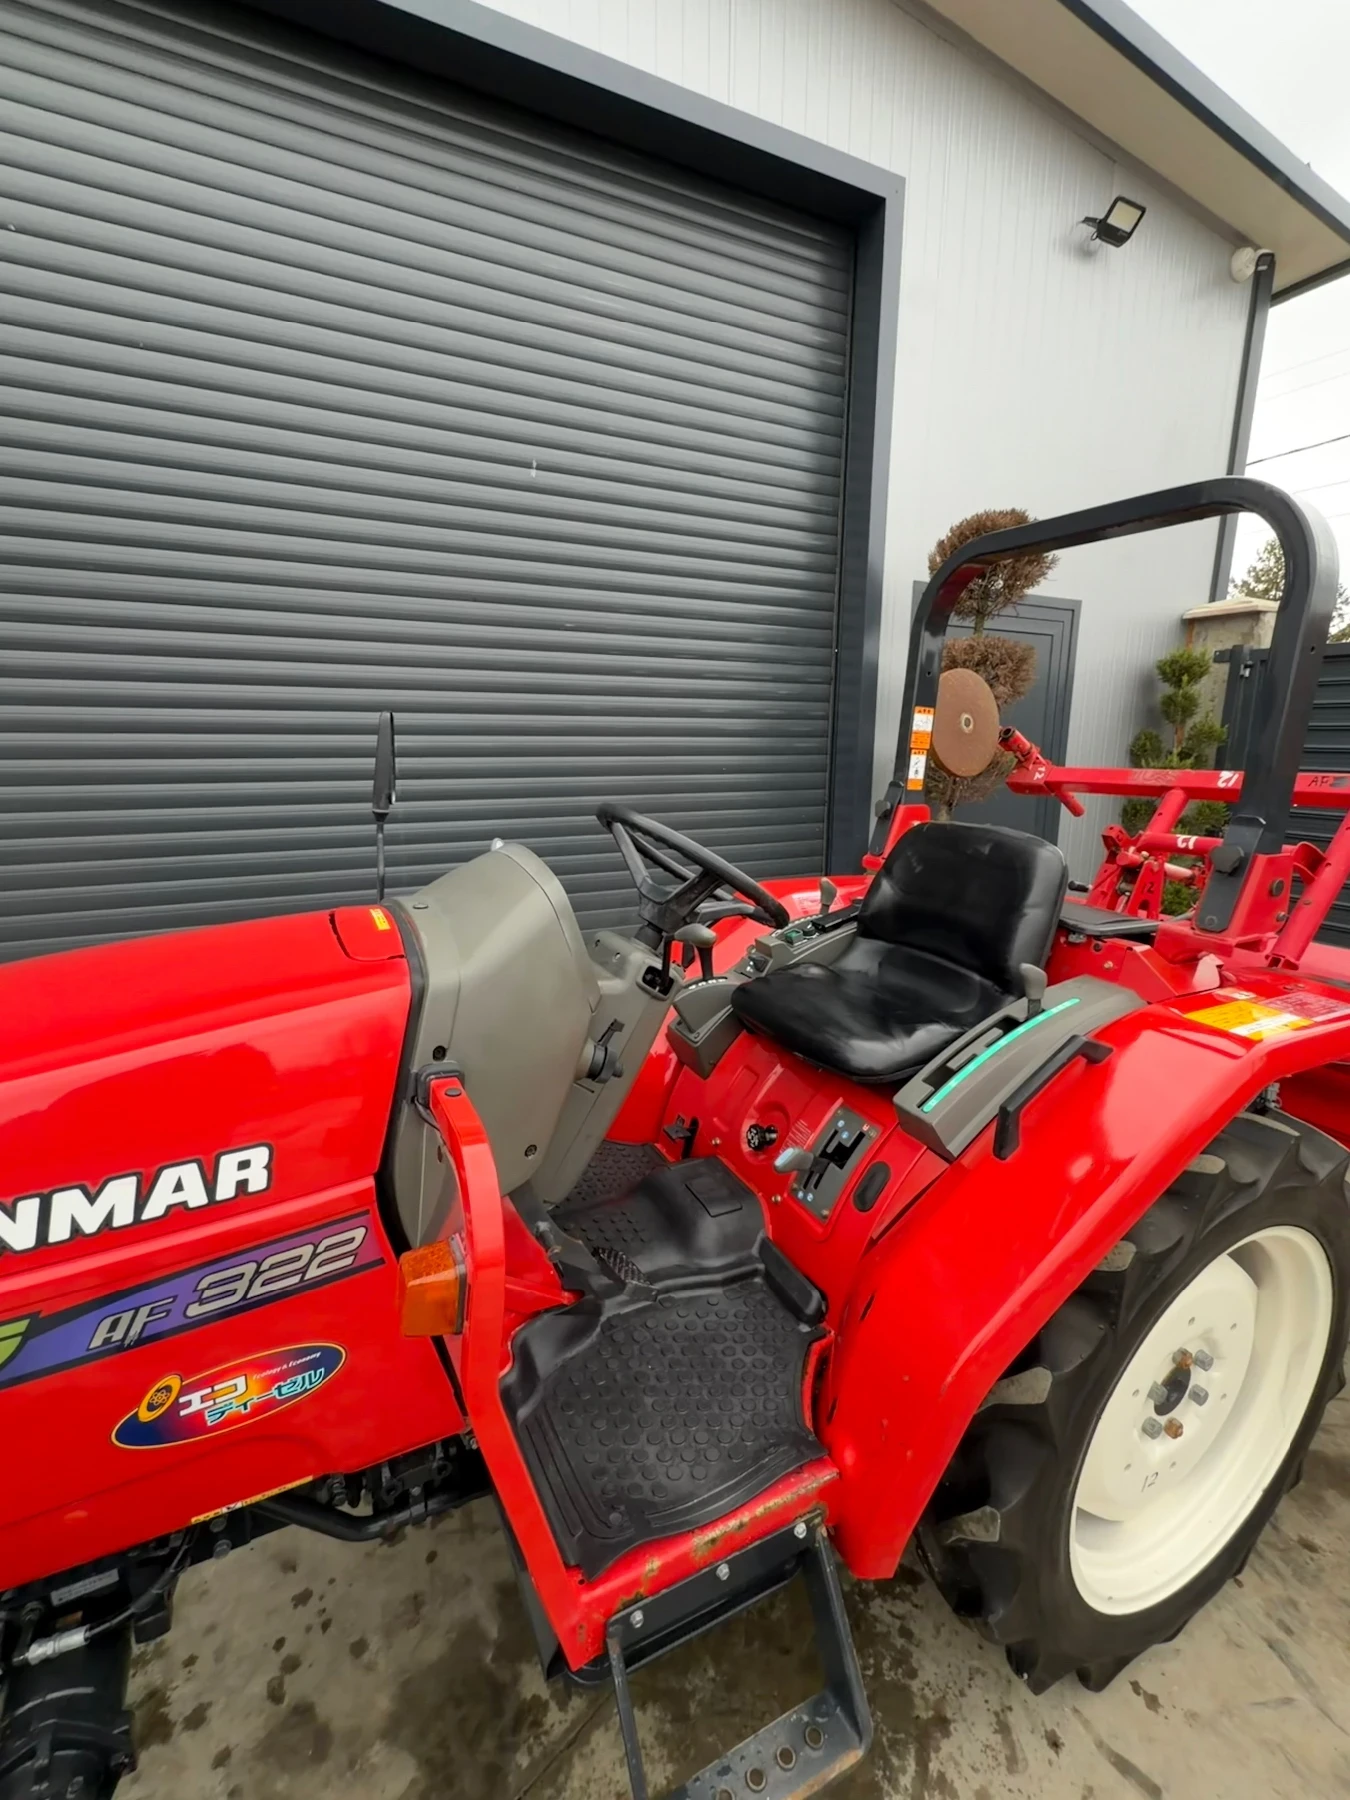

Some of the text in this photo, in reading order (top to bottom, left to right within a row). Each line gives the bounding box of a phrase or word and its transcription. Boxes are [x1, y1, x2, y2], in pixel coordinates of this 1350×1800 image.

[87, 1226, 368, 1350] AF 322
[289, 1352, 321, 1368] Economy
[178, 1374, 248, 1417] エコ
[205, 1367, 325, 1427] ディーゼル
[1140, 1471, 1159, 1492] 12
